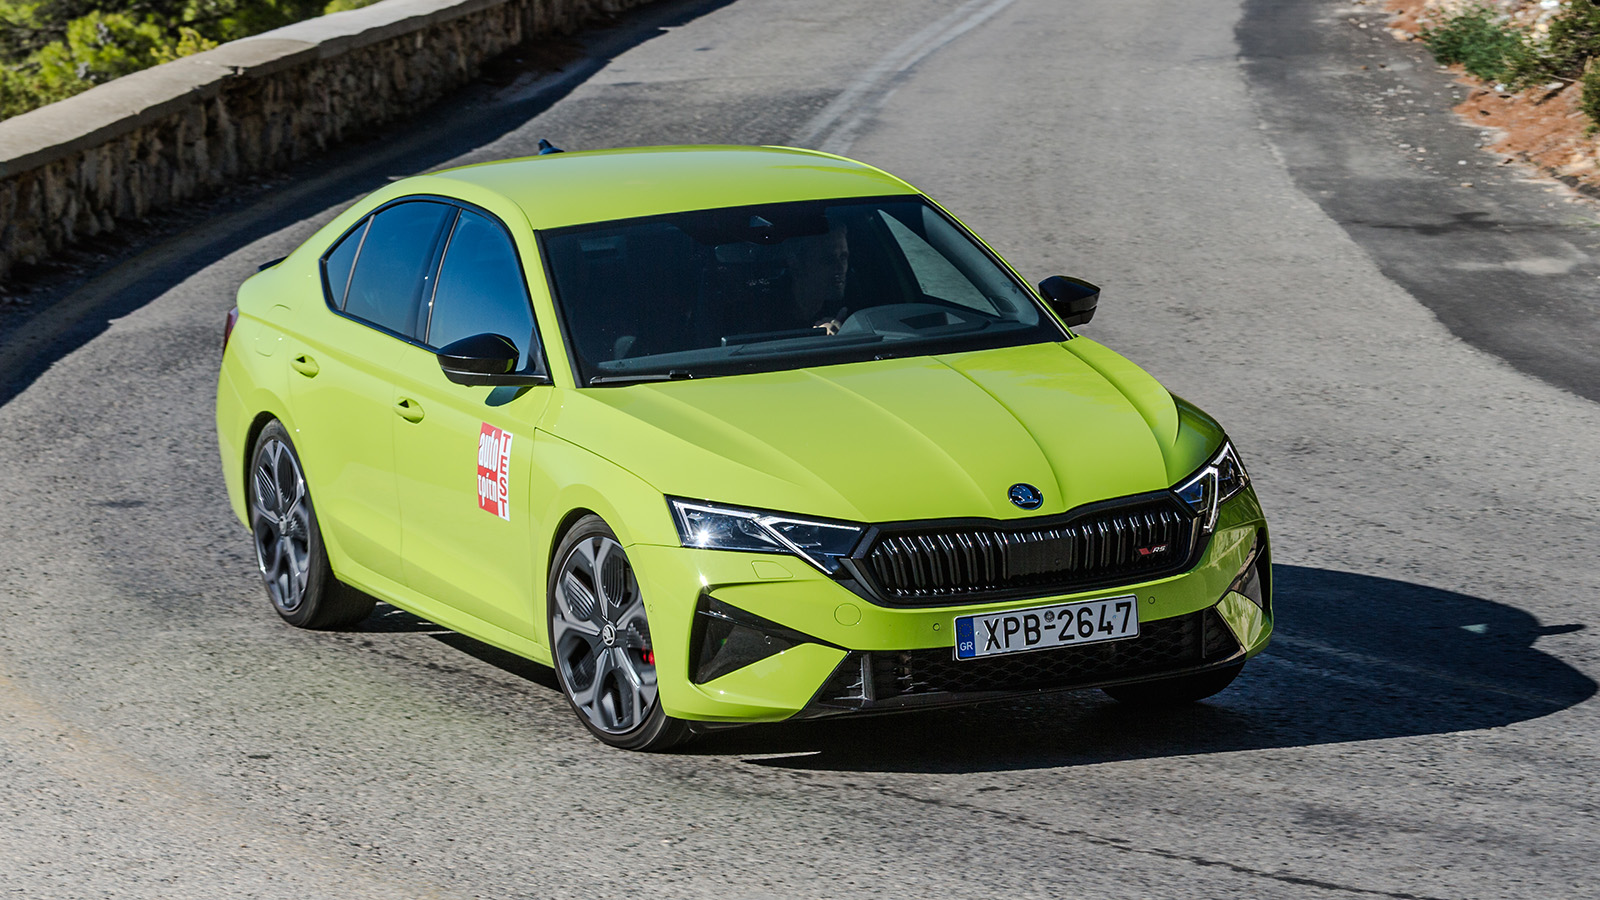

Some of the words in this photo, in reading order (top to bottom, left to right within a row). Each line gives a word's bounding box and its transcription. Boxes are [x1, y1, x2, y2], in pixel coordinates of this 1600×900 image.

[478, 429, 499, 473] auto
[499, 432, 511, 518] TEST
[959, 641, 974, 652] GR
[983, 601, 1132, 651] XPB-2647
